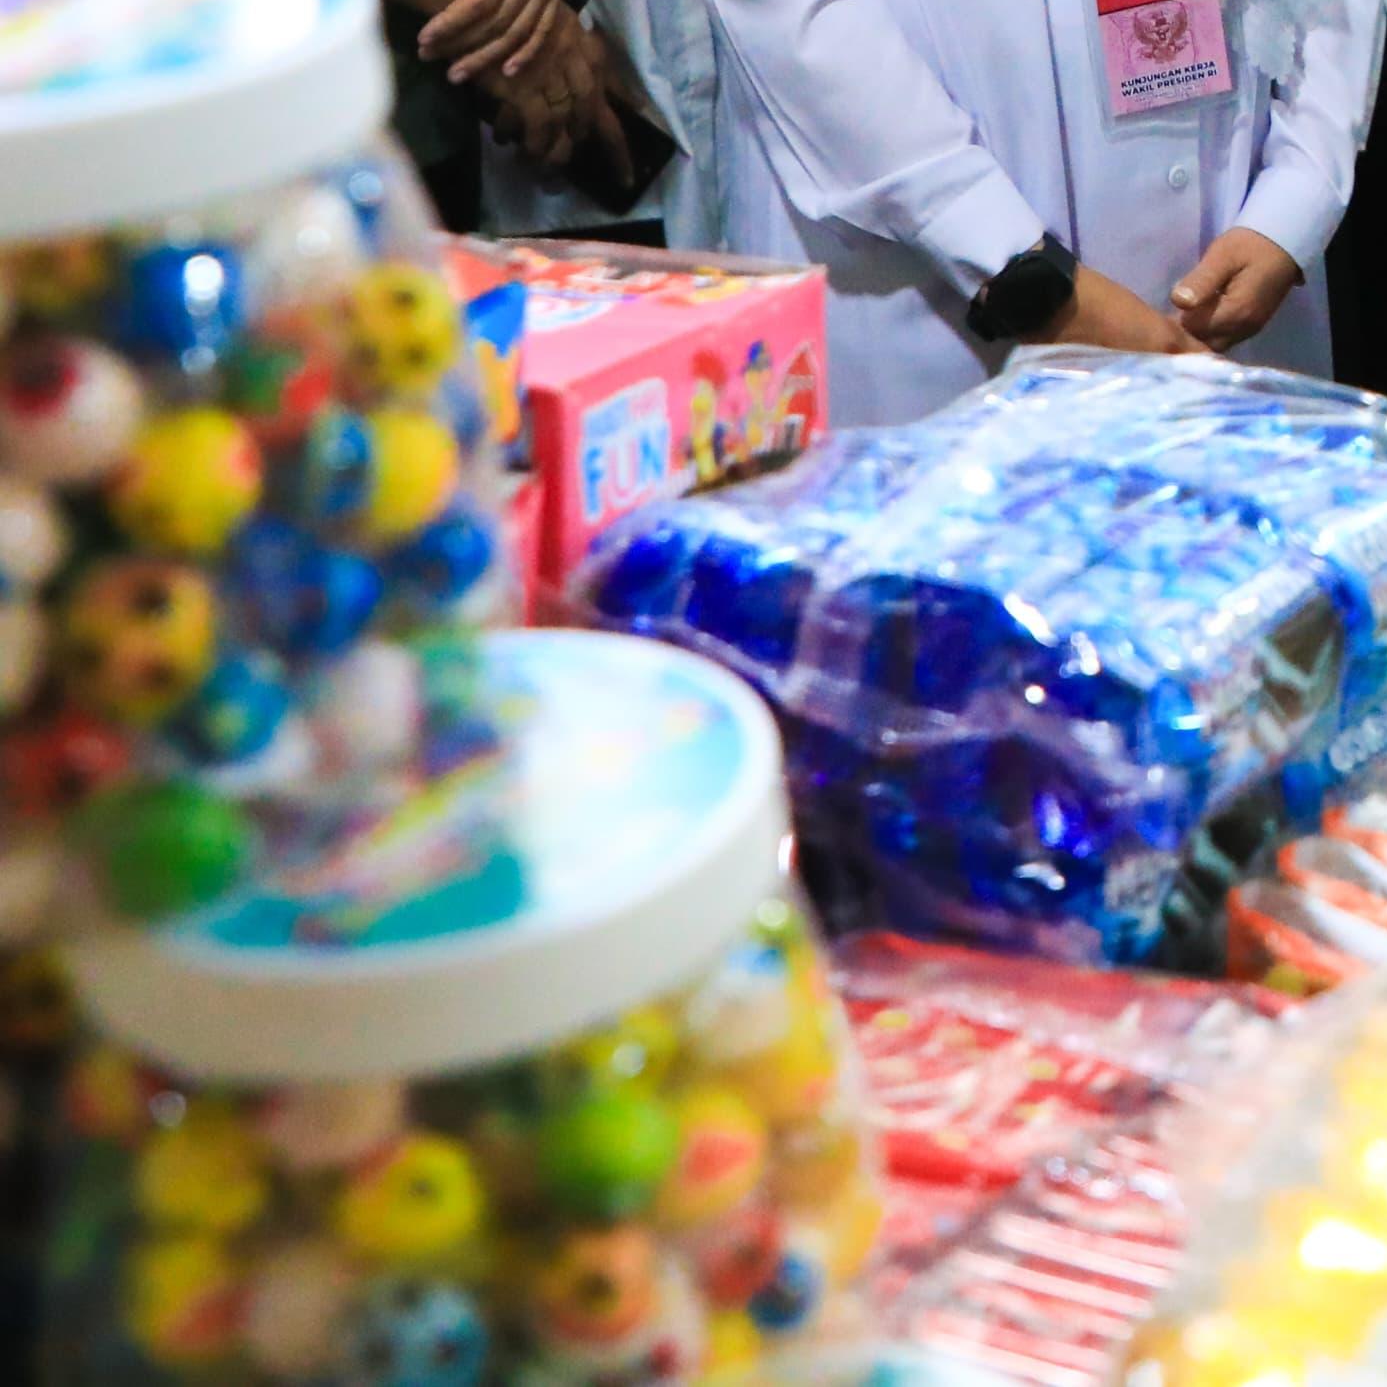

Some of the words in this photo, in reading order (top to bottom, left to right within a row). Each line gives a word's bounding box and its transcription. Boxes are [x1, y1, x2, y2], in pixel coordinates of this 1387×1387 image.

[1120, 68, 1182, 89] KUNJUNGAN
[1184, 60, 1216, 74] KERJA
[1121, 83, 1155, 97] WAKIL
[1156, 71, 1206, 89] PRESIDEN
[1207, 69, 1218, 77] RI
